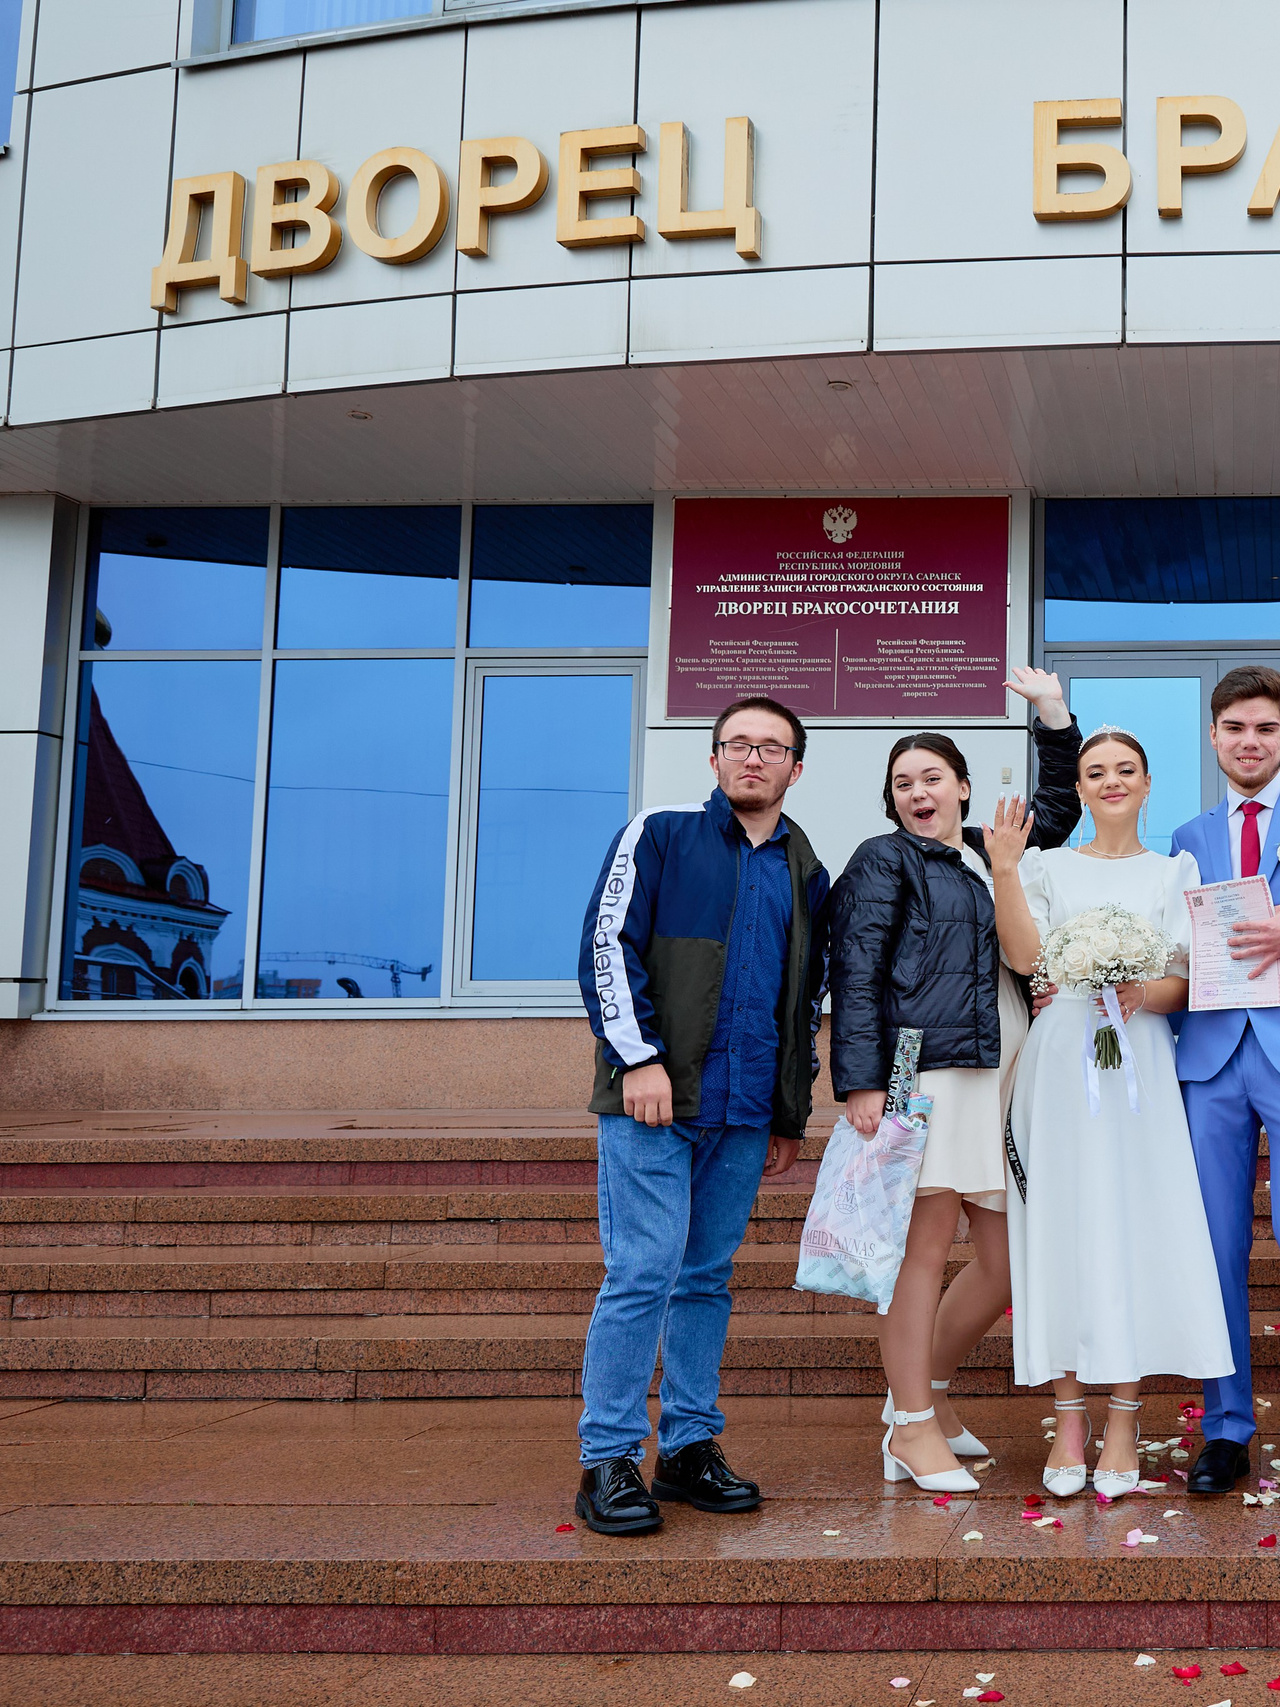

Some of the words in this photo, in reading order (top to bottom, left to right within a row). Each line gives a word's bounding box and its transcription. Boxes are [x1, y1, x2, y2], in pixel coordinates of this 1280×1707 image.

[151, 116, 762, 313] ДВОРЕЦ
[776, 550, 844, 559] РОССИЙСКАЯ
[846, 551, 905, 559] ФЕДЕРАЦИЯ
[779, 562, 844, 570] РЕСПУБЛИКА
[847, 562, 901, 570] МОРДОВИЯ
[718, 573, 807, 582] АДМИНИСТРАЦИЯ
[809, 573, 874, 582] ГОРОДСКОГО
[876, 573, 914, 581] ОКРУГА
[696, 585, 761, 593] УПРАВЛЕНИЕ
[840, 584, 919, 592] ГРАЖДАНСКОГО
[921, 584, 984, 592] СОСТОЯНИЯ
[714, 601, 788, 617] ДВОРЕЦ
[791, 601, 960, 615] БРАКОСОЧЕТАНИЯ
[710, 648, 747, 656] Мордовия
[736, 656, 767, 664] Саранск
[903, 656, 934, 664] Саранск
[602, 852, 629, 908] men
